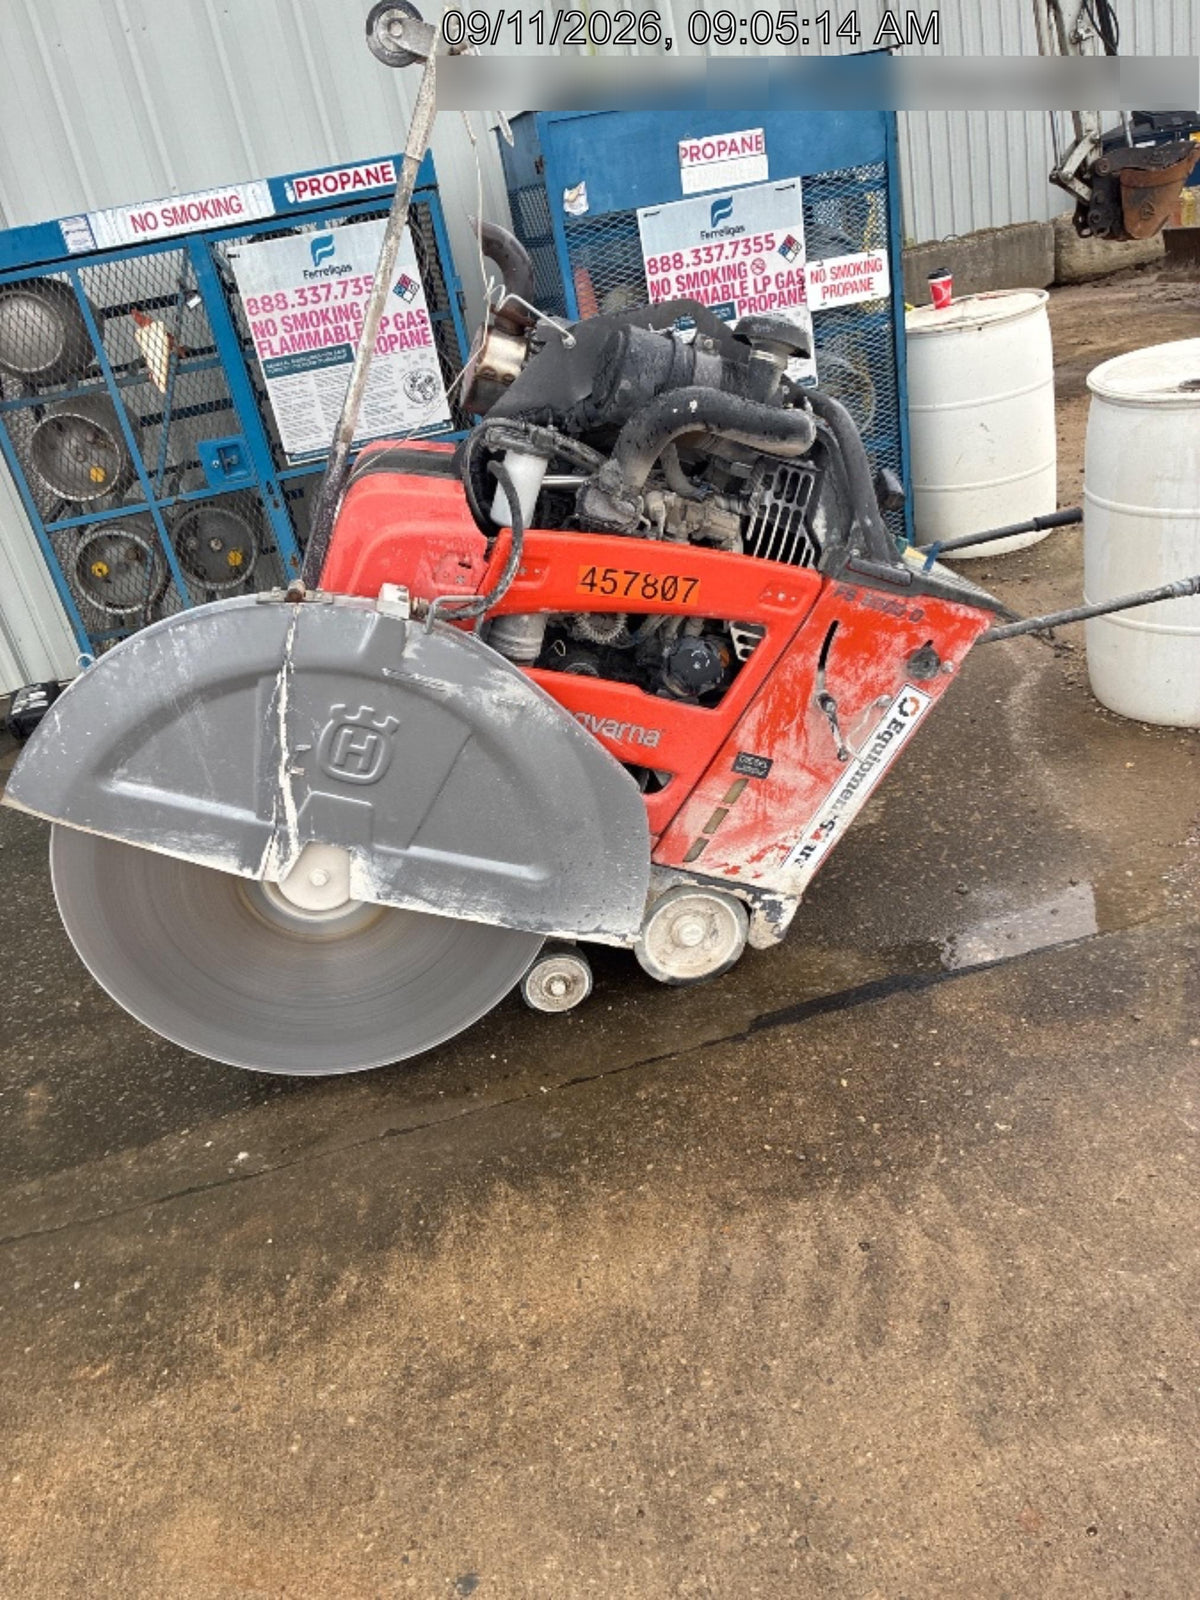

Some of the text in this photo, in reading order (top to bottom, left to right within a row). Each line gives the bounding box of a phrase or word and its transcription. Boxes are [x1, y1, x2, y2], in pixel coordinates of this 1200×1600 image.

[681, 135, 763, 162] PROPANE
[295, 164, 393, 199] PROPANE
[130, 195, 243, 233] NO SMOKING
[700, 224, 746, 240] Ferrellgas
[647, 233, 776, 275] 888.337.7355
[810, 257, 883, 285] NO SMOKING
[246, 275, 374, 316] 888.337.735
[650, 261, 747, 297] NO SMOKING
[653, 267, 805, 304] MABLE LP GAS
[822, 277, 874, 300] PROPANE
[738, 287, 807, 316] PROPANE
[252, 301, 362, 340] NO SMOKING
[393, 309, 428, 331] GAS
[580, 566, 699, 603] 457807
